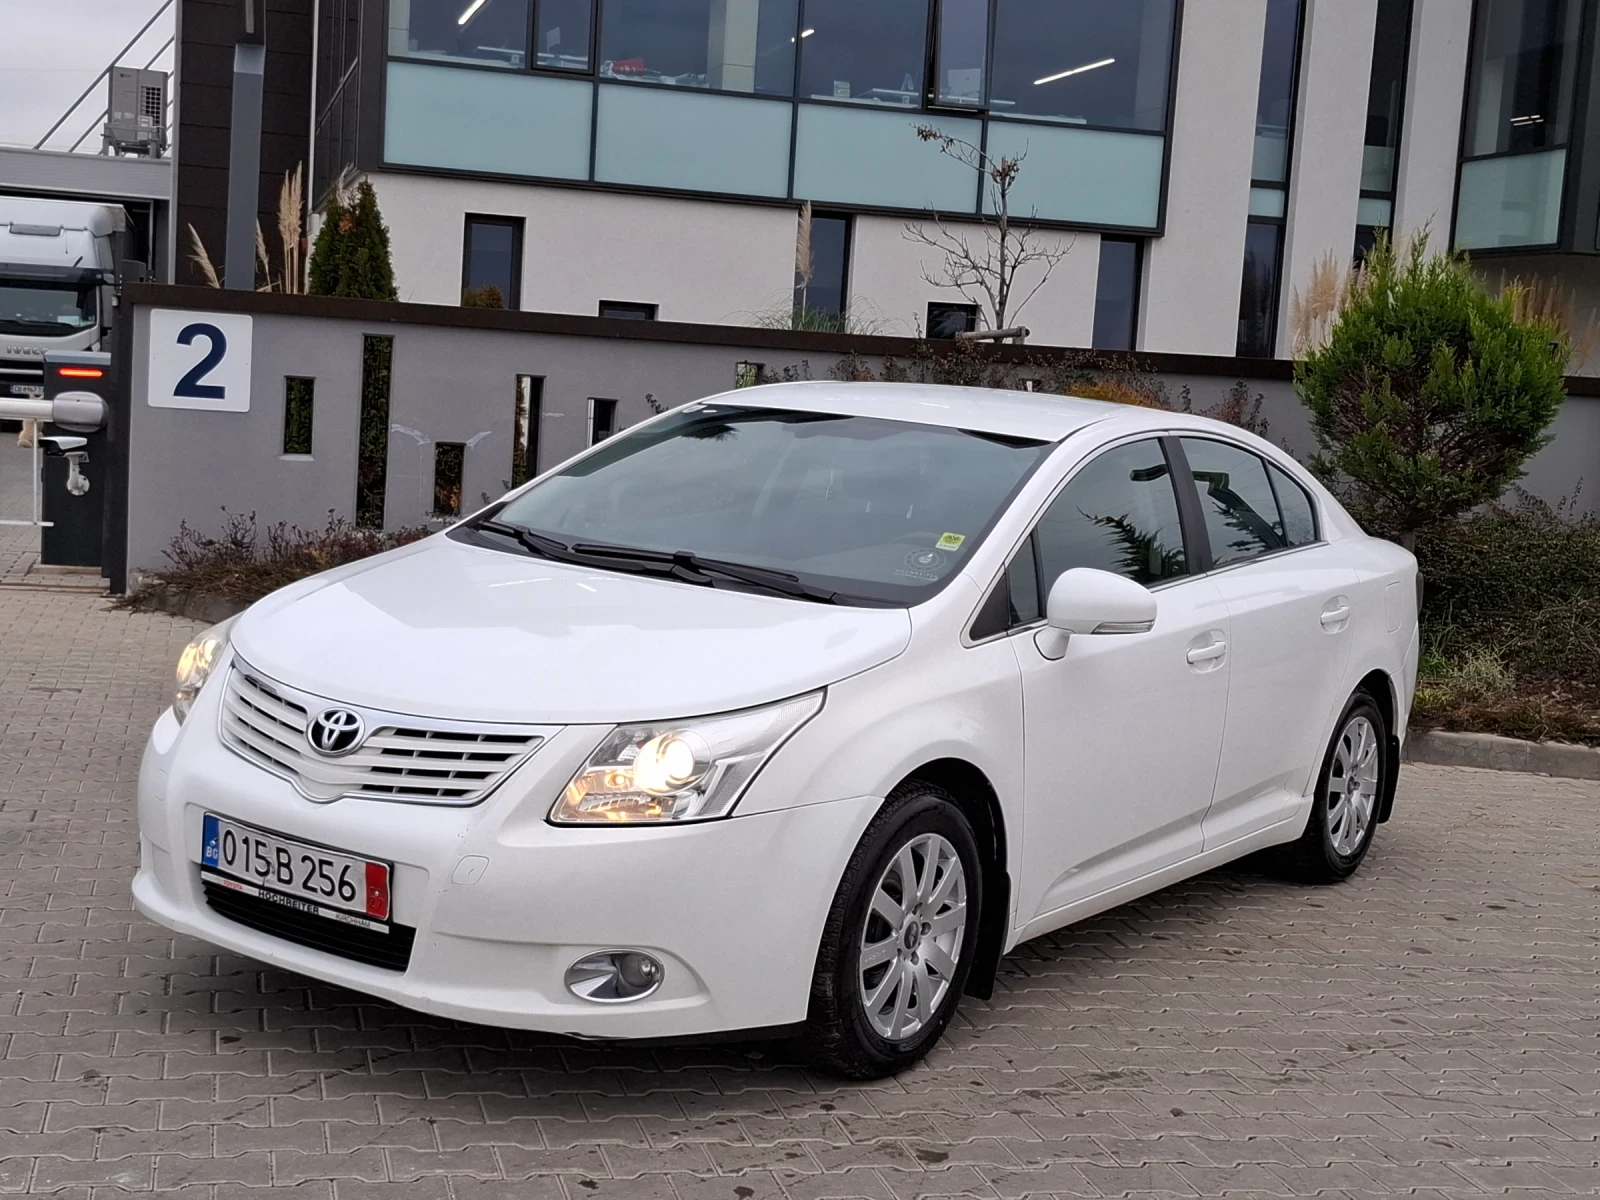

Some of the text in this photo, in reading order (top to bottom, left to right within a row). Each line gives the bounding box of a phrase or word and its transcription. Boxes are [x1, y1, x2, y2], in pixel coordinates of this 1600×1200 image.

[7, 345, 49, 356] IVECO
[173, 322, 228, 400] 2
[206, 846, 219, 859] BG
[223, 880, 244, 890] TOYOTA
[258, 889, 319, 914] HOCHREITER
